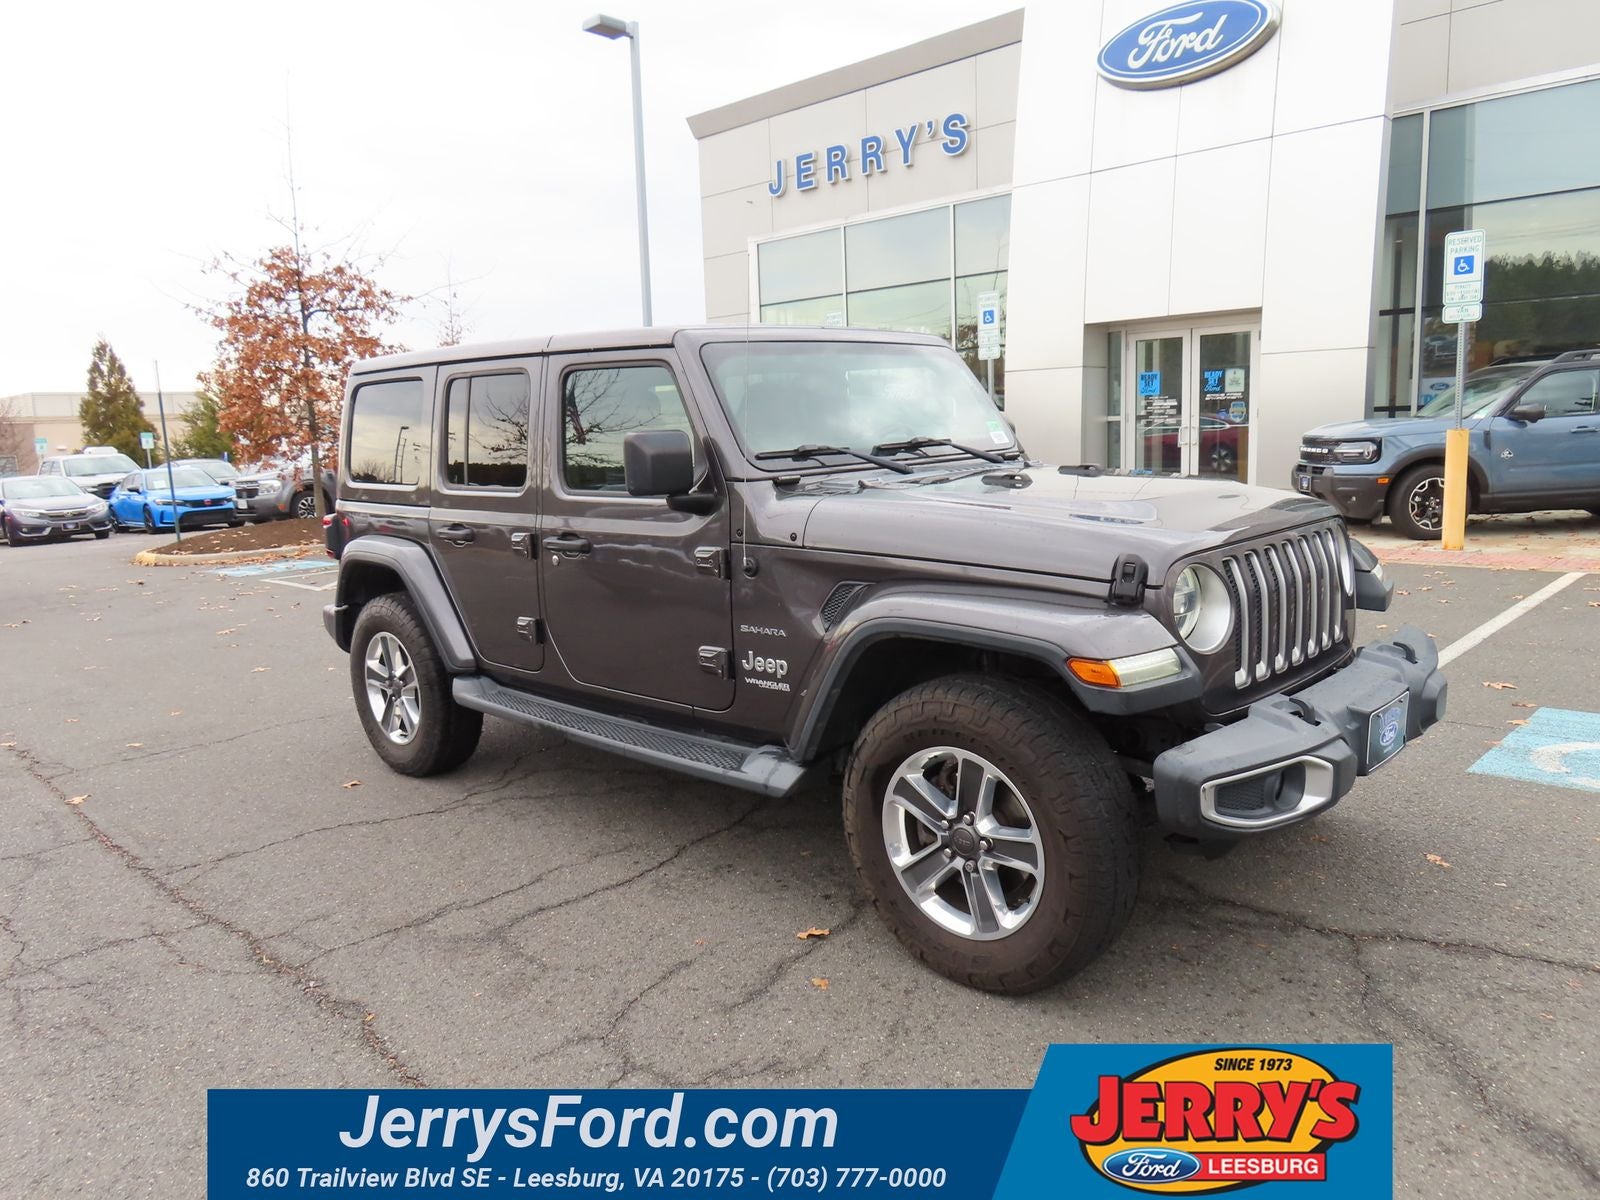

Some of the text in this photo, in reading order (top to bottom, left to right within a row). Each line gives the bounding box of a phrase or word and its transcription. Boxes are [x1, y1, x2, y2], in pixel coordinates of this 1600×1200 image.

[1127, 12, 1228, 69] Ford
[768, 112, 970, 197] JERRY'S
[1450, 244, 1480, 254] PARKING
[740, 624, 787, 637] SAHARA
[741, 650, 788, 678] Jeep
[744, 677, 790, 689] WRANGLER
